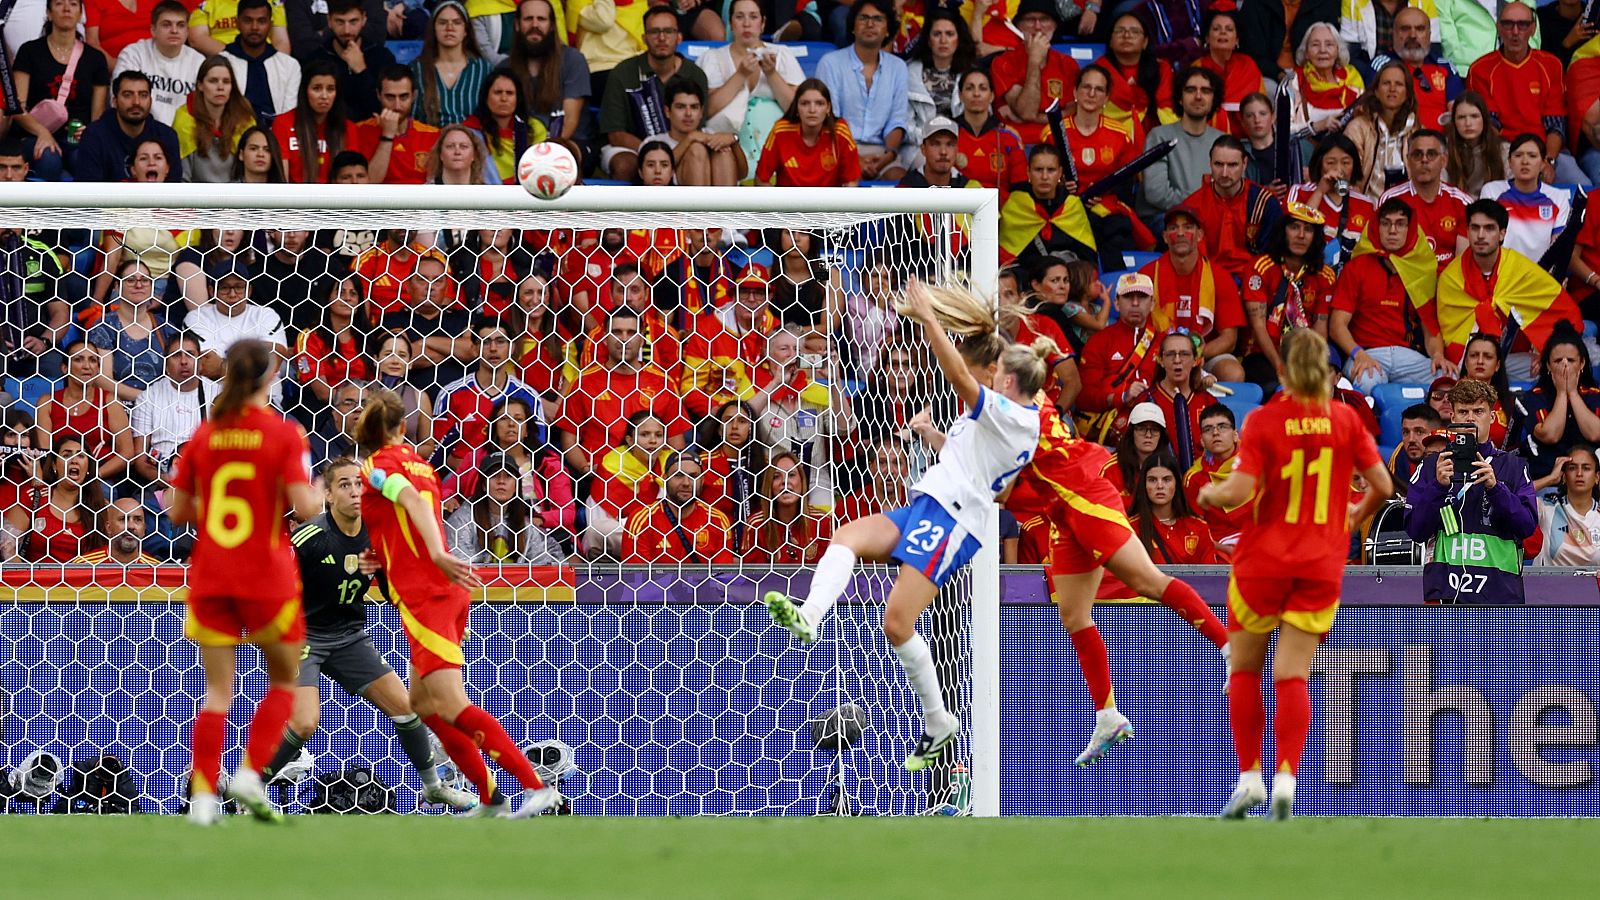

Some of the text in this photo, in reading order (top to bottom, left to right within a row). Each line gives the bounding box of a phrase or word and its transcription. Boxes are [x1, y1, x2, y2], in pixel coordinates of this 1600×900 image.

[146, 73, 196, 95] RMON
[1285, 417, 1332, 436] ALEXIA
[1281, 446, 1333, 525] 11
[206, 461, 256, 550] 6
[906, 519, 945, 552] 23
[1451, 537, 1487, 561] HB
[337, 579, 362, 605] 13
[1448, 572, 1488, 594] 027
[1309, 643, 1599, 787] The
